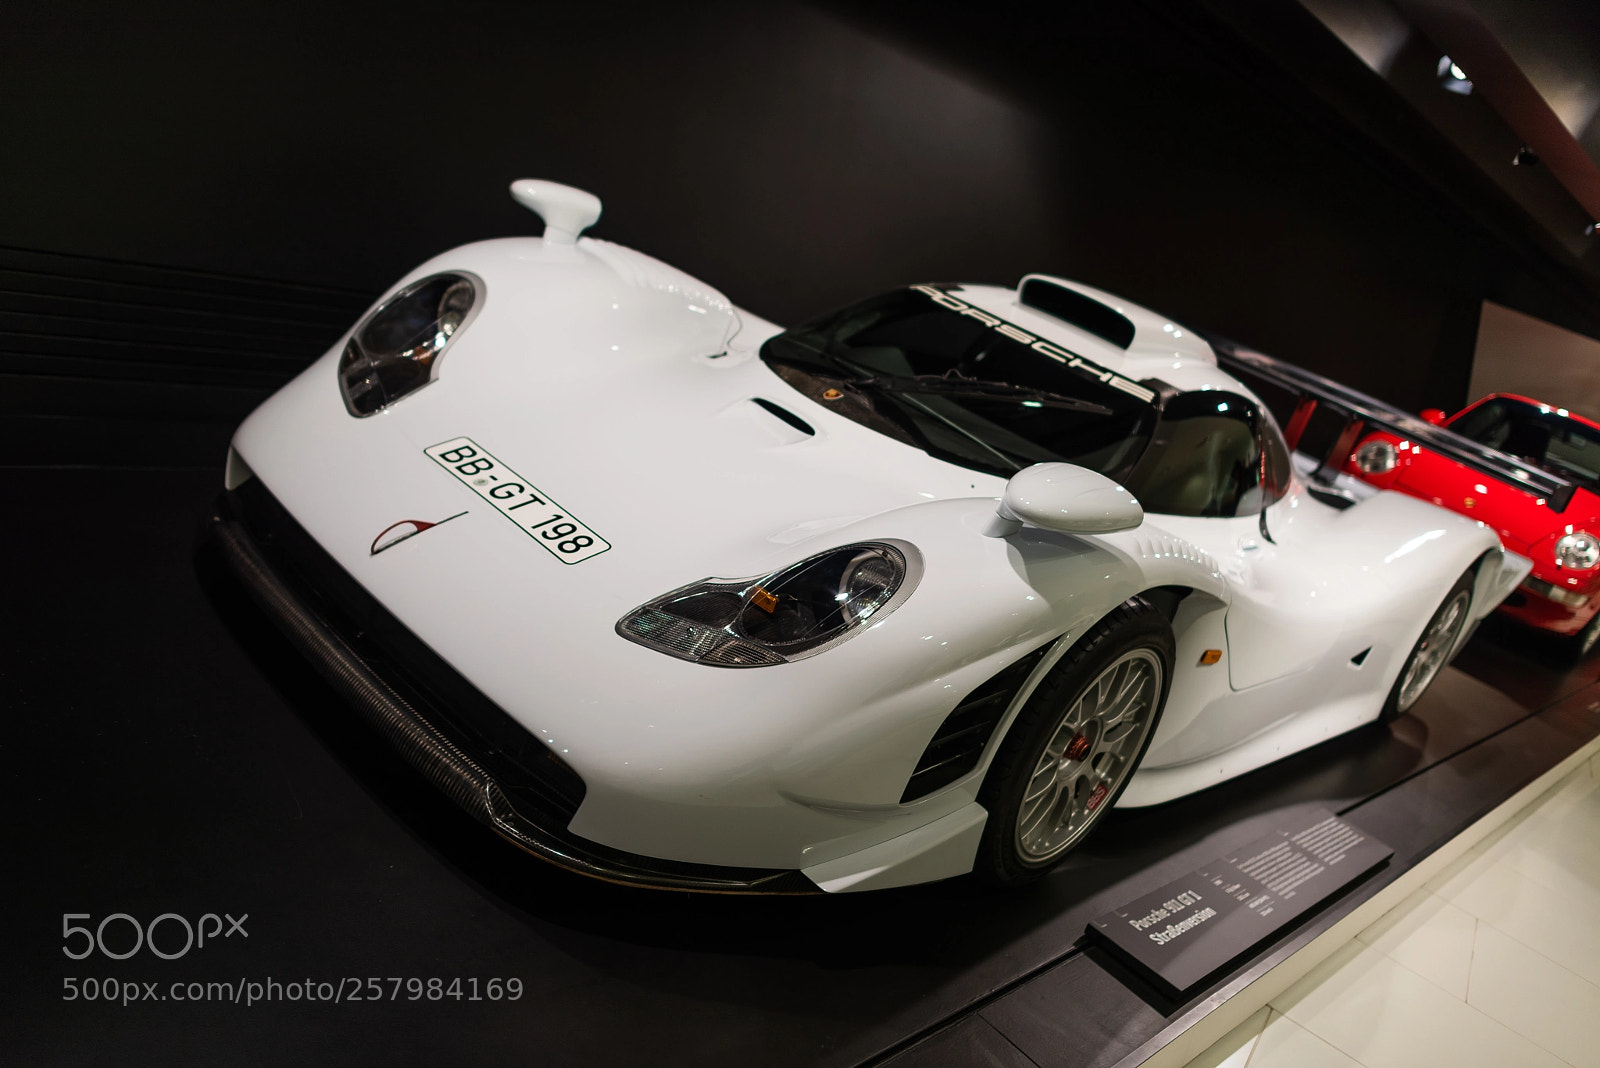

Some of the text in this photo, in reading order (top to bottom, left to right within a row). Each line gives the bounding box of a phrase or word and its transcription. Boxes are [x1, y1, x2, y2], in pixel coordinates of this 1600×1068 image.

[909, 284, 1155, 403] PORSCHE
[531, 513, 594, 554] 198
[1128, 908, 1171, 931] Porsche
[1162, 898, 1186, 913] 911
[1148, 907, 1217, 945] Straßenversion
